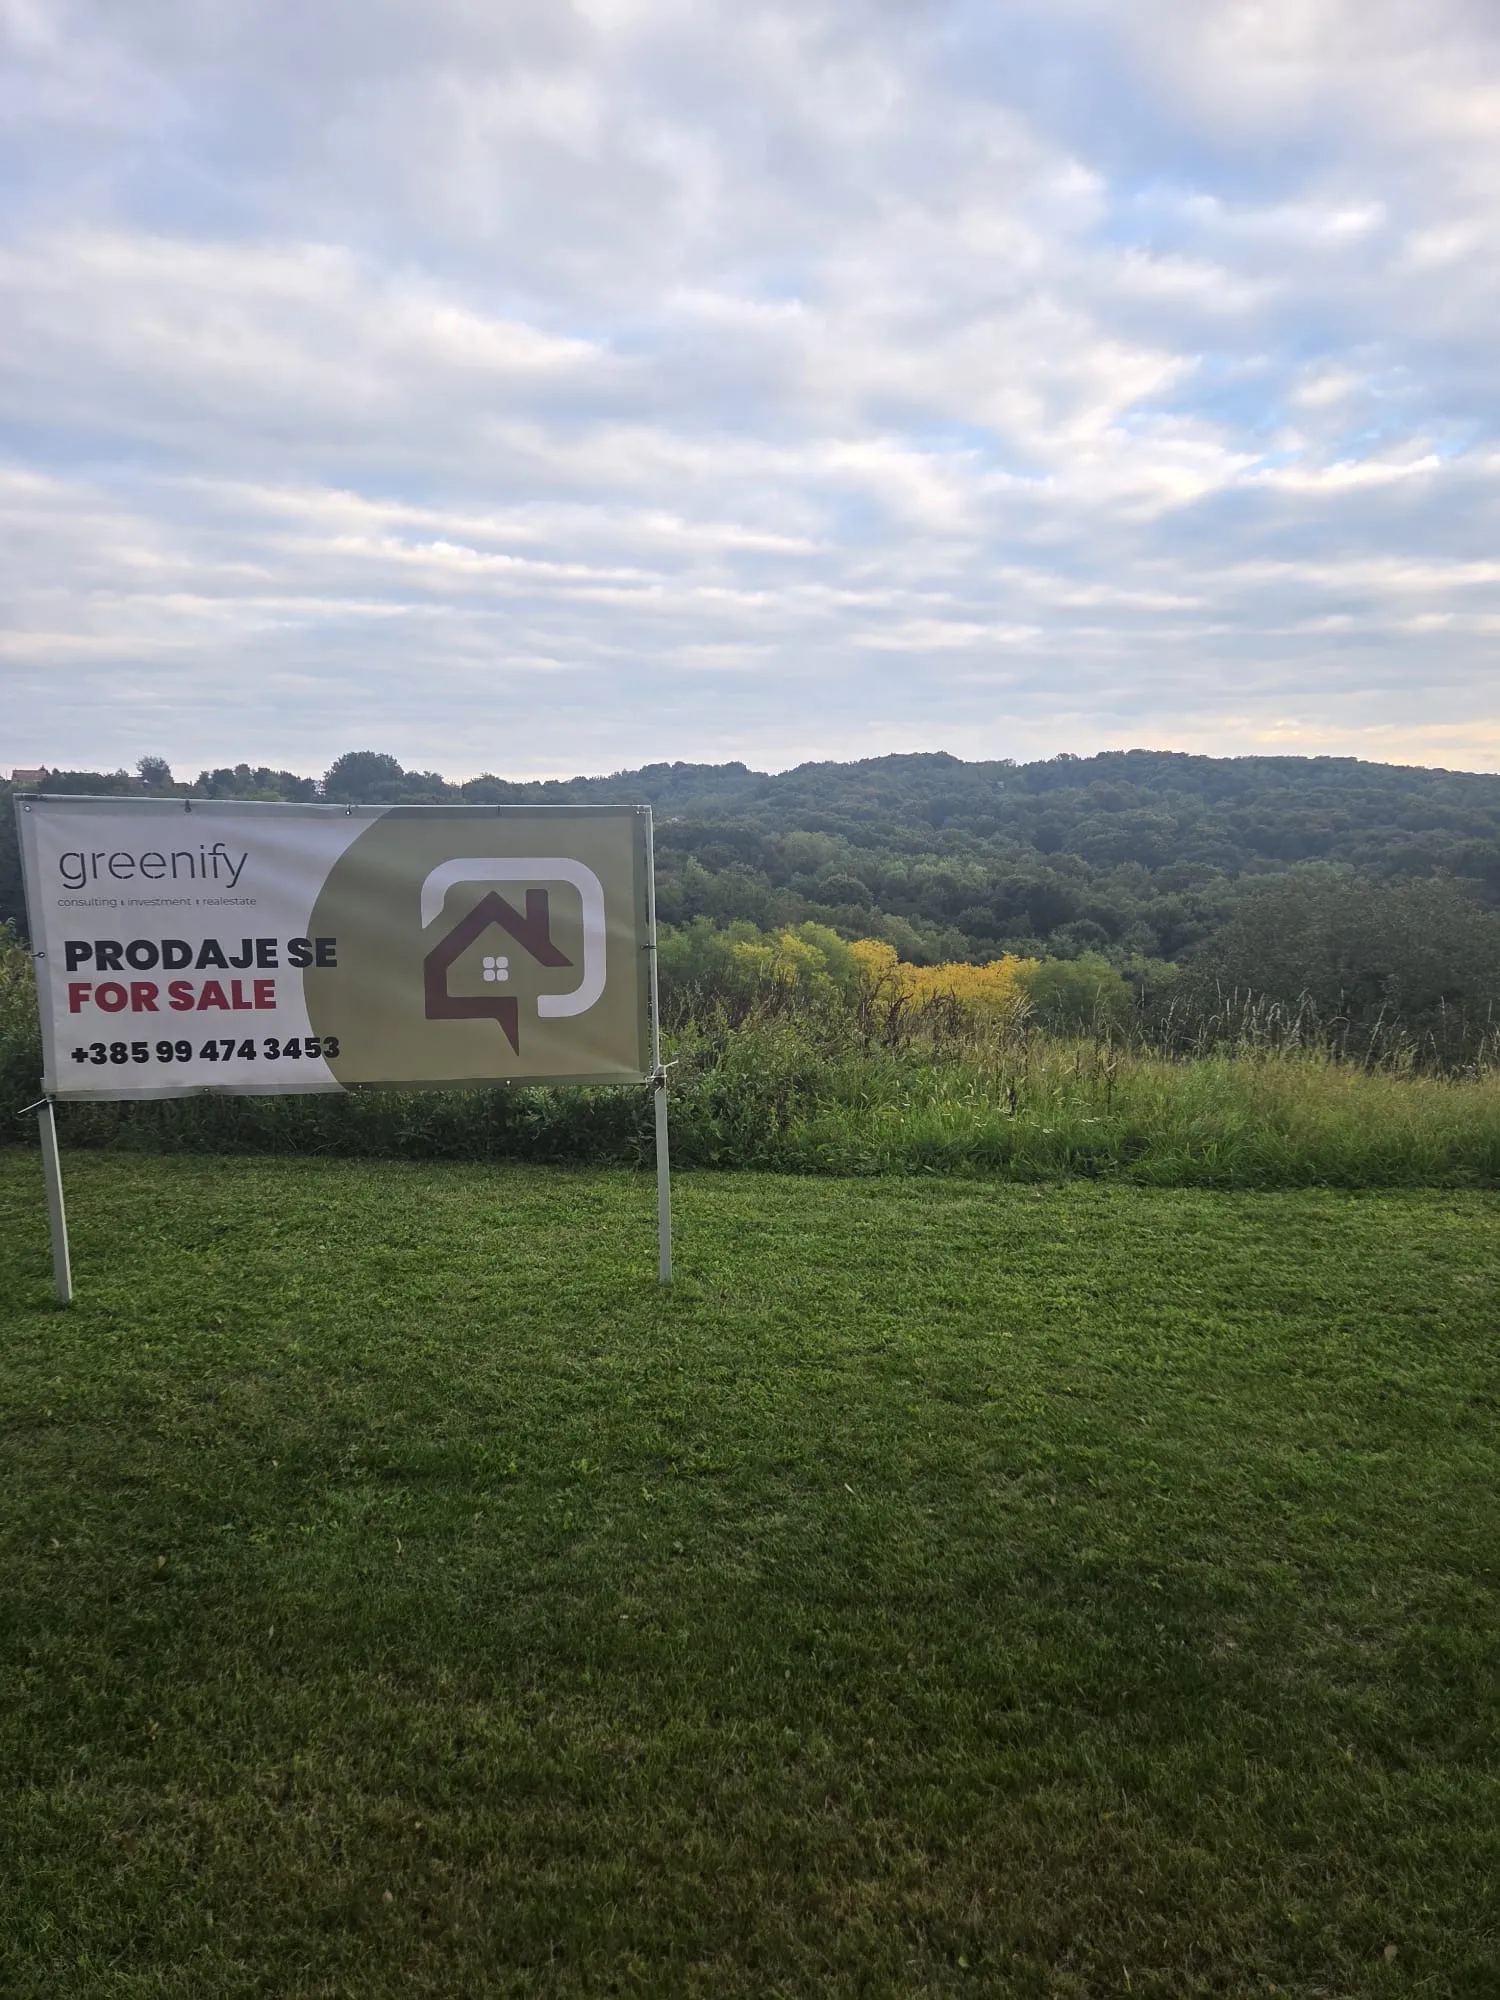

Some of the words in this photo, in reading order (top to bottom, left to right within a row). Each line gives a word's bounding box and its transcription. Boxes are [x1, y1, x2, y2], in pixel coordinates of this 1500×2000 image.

[59, 842, 248, 890] greenify
[57, 896, 118, 909] consulting
[127, 896, 192, 907] investment
[202, 896, 257, 906] realestate
[64, 938, 279, 972] PRODAJE
[287, 937, 338, 968] SE
[68, 981, 160, 1014] FOR
[168, 979, 277, 1012] SALE
[71, 1041, 150, 1065] +385
[156, 1040, 193, 1063] 99
[199, 1039, 257, 1062] 474
[263, 1036, 341, 1061] 3453
